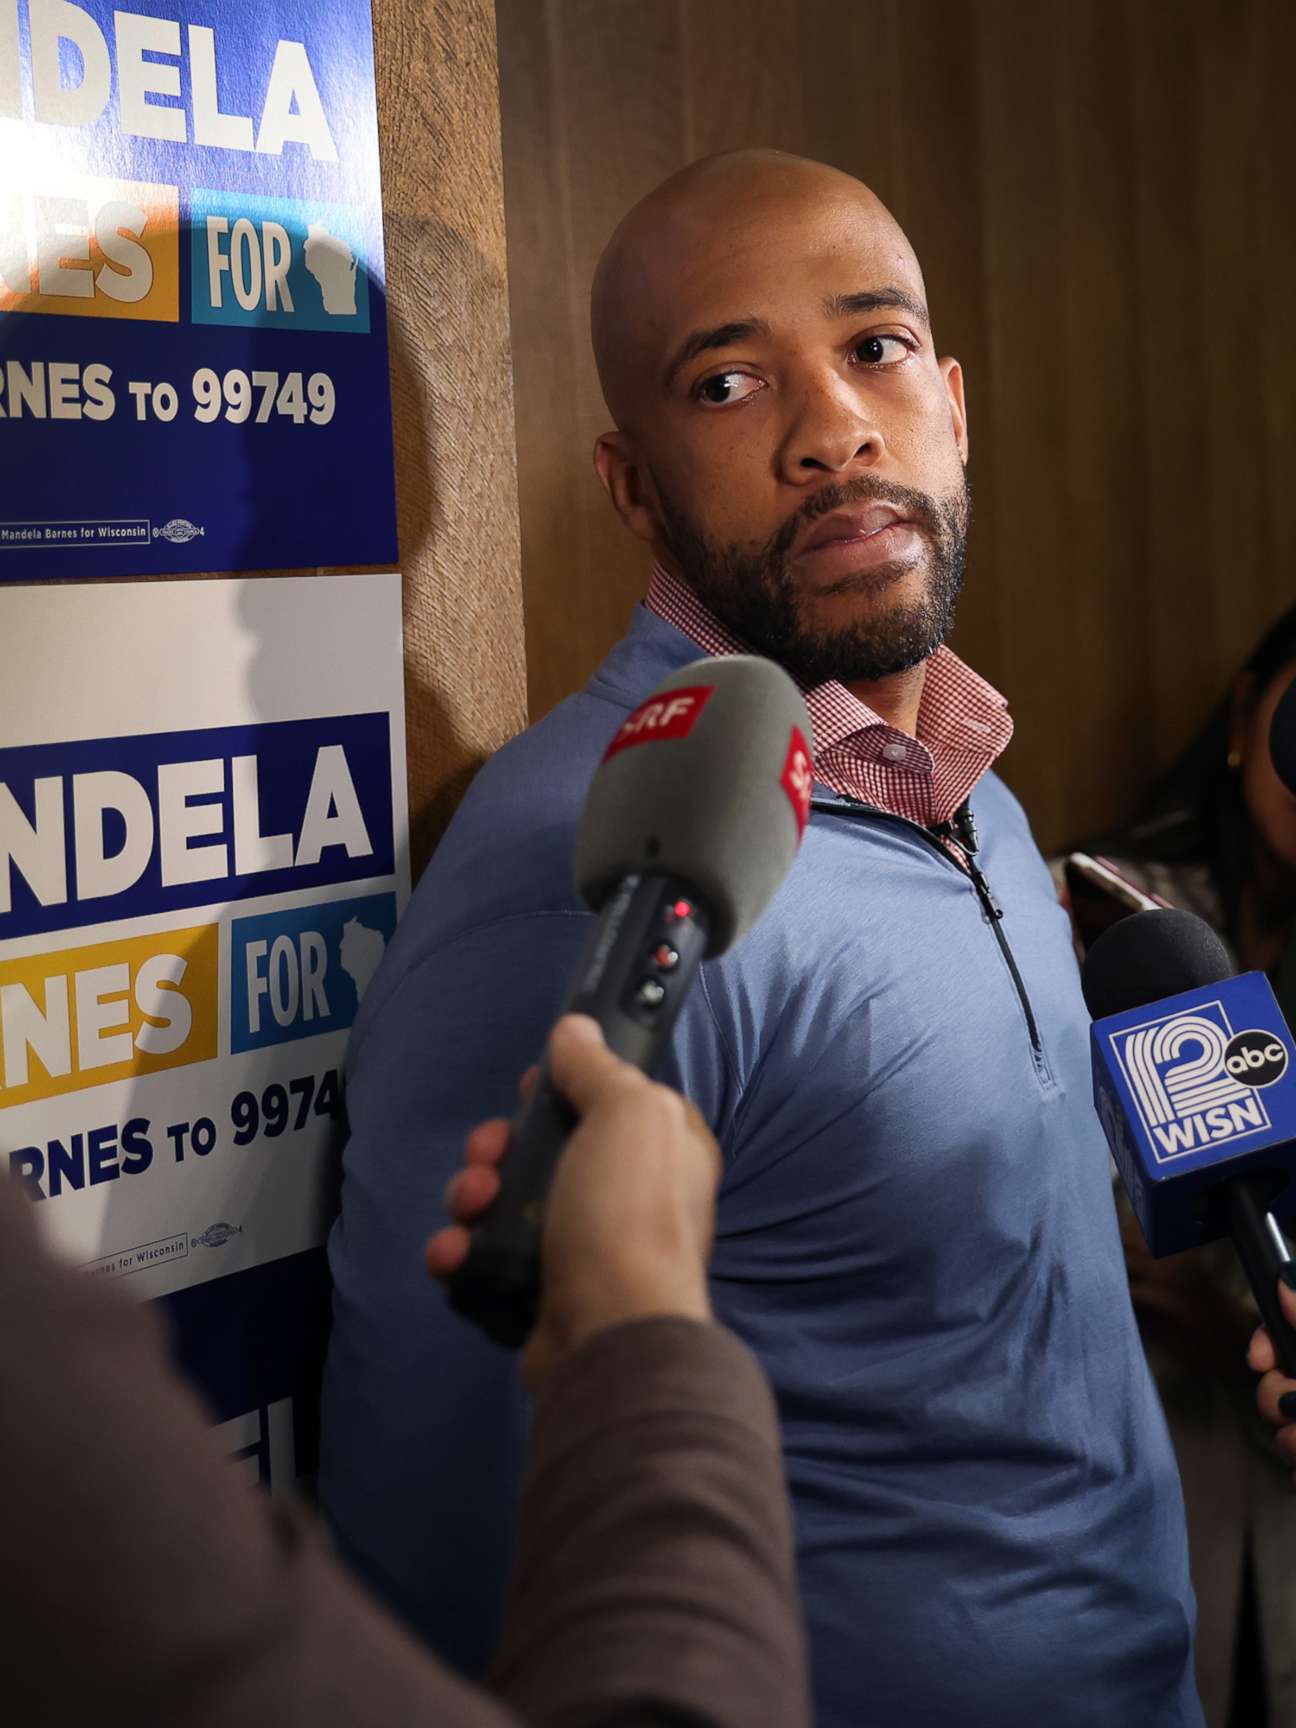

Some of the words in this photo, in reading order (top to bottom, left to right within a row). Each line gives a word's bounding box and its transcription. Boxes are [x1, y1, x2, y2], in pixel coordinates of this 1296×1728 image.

[0, 0, 339, 162] DELA
[207, 216, 294, 313] FOR
[0, 361, 116, 421] NES
[192, 368, 336, 425] 99749
[1, 528, 42, 540] Mandela
[45, 527, 77, 539] Barnes
[80, 526, 96, 537] for
[98, 526, 146, 537] Wisconsin
[0, 744, 374, 912] NDELA
[0, 954, 192, 1088] NES
[246, 931, 332, 1034] FOR
[1125, 1016, 1252, 1127] 12
[1226, 1043, 1284, 1074] abc
[9, 1117, 153, 1200] RNES
[230, 1069, 341, 1146] 9974
[1152, 1097, 1263, 1154] WISN
[119, 1256, 134, 1269] for
[136, 1240, 184, 1263] Wisconsin
